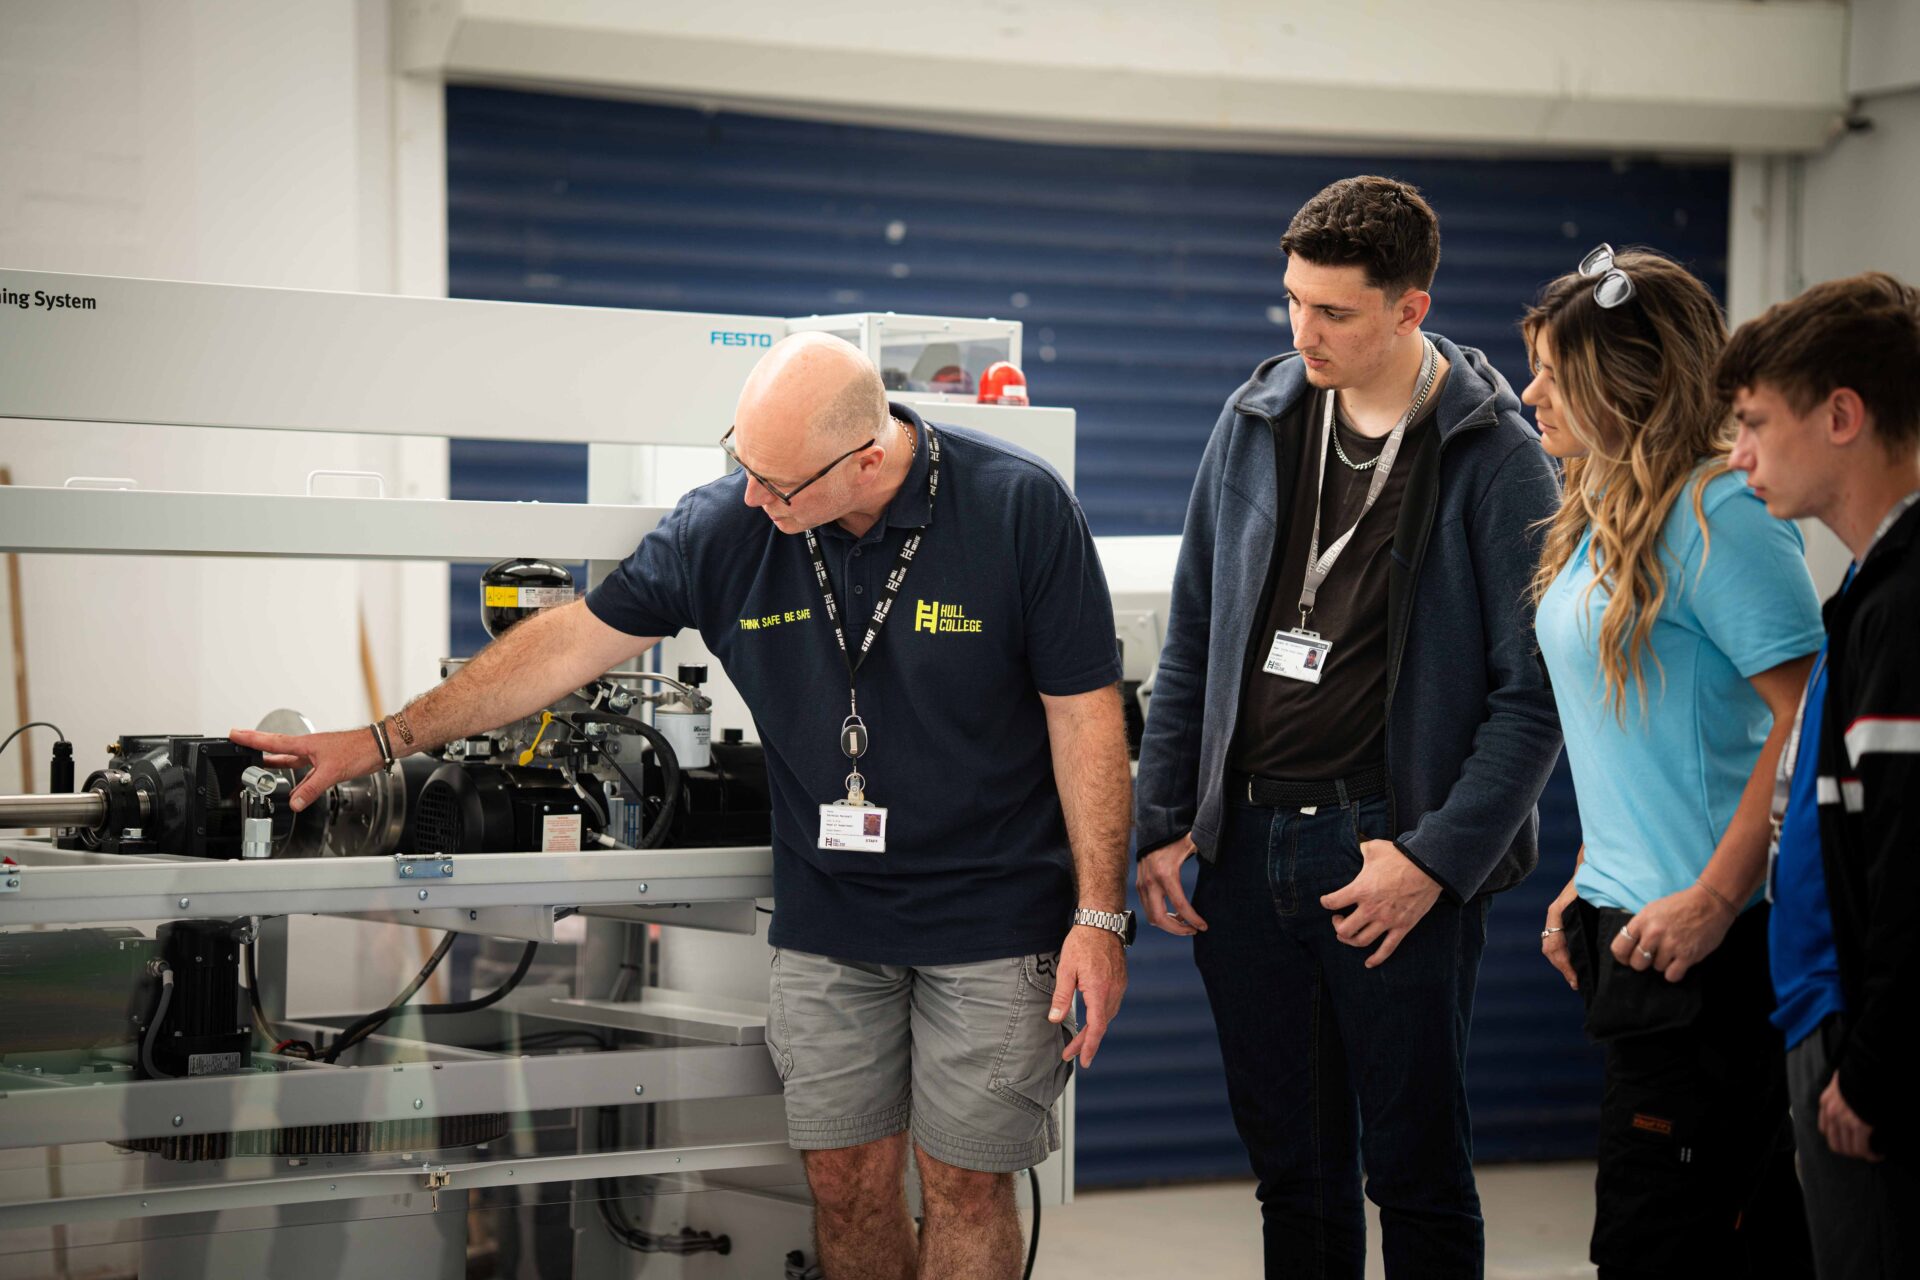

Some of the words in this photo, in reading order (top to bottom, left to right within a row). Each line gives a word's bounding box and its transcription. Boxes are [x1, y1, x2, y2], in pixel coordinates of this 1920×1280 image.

[0, 288, 30, 309] ing
[34, 290, 96, 311] System
[711, 331, 771, 347] FESTO
[1315, 542, 1343, 576] STUDENT
[740, 619, 760, 630] THINK
[761, 614, 781, 628] SAFE
[783, 611, 795, 623] BE
[796, 608, 811, 620] SAFE
[940, 604, 965, 618] HULL
[939, 618, 983, 632] COLLEGE
[835, 627, 846, 651] STAFF
[861, 627, 876, 652] STAFF
